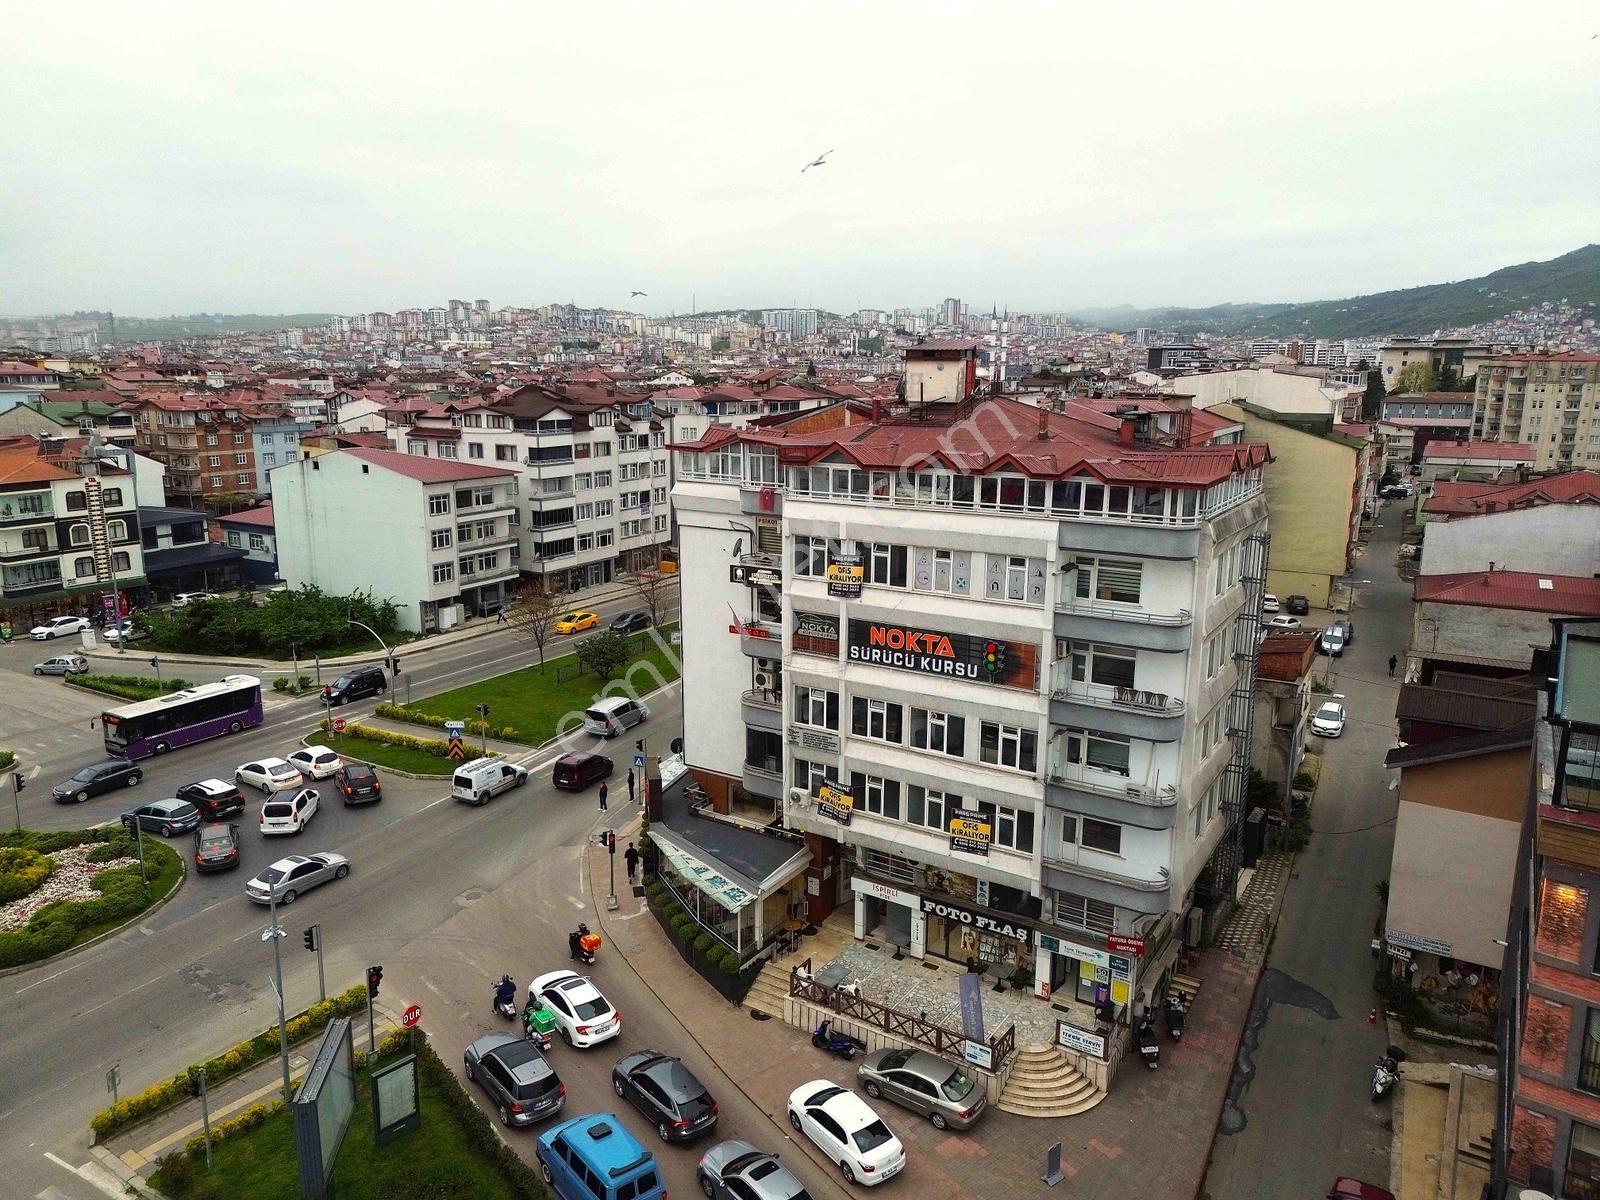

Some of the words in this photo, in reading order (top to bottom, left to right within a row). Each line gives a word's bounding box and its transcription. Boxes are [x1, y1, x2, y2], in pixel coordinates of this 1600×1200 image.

[801, 622, 837, 634] NOKTA
[870, 625, 956, 658] NOKTA
[850, 645, 915, 668] SÜRÜCÜ
[920, 656, 978, 679] KURSU
[923, 900, 973, 924] FOTO
[975, 915, 1028, 943] FLAŞ
[403, 1008, 421, 1024] DUR
